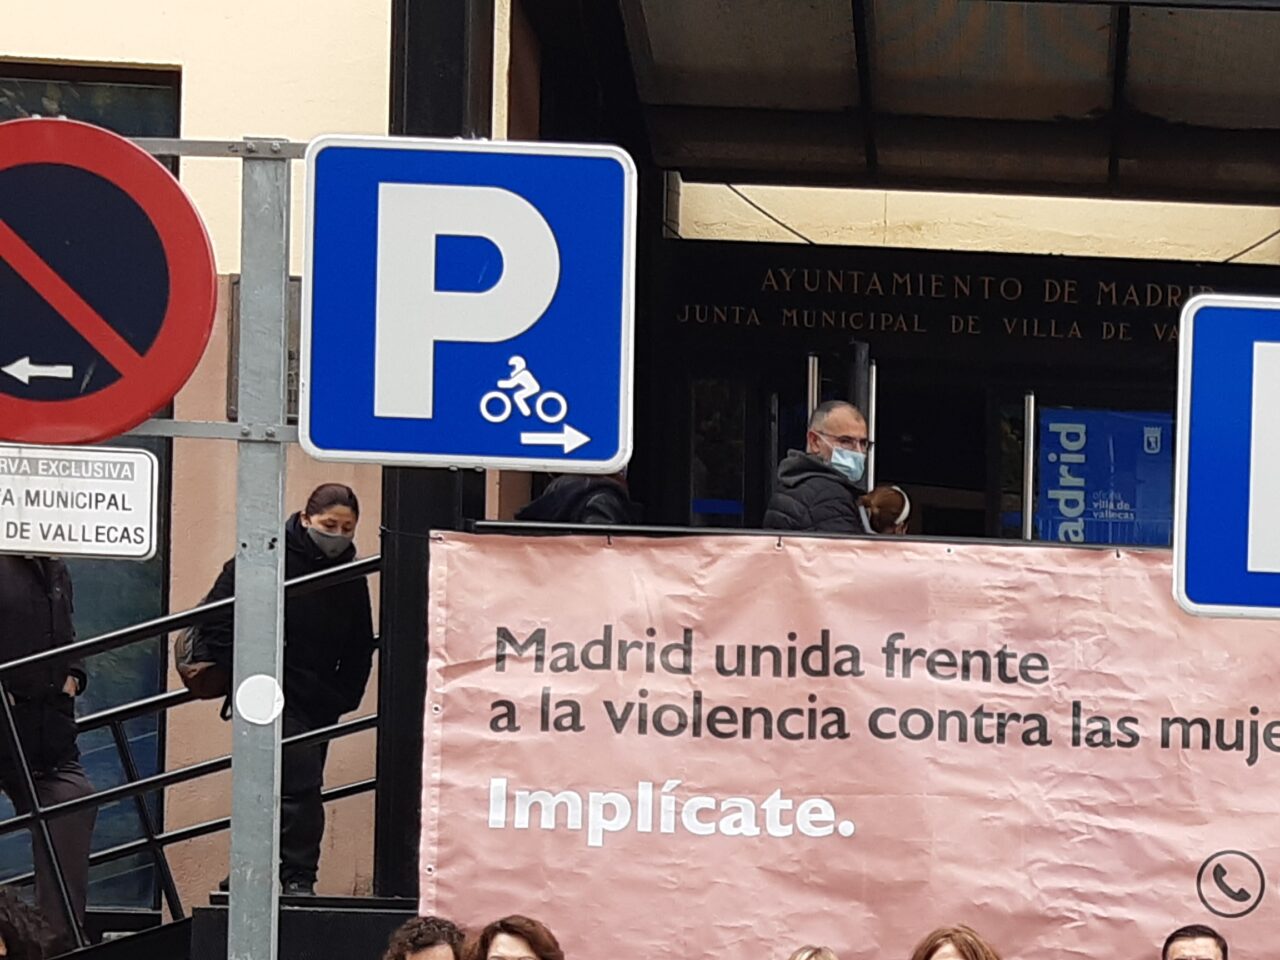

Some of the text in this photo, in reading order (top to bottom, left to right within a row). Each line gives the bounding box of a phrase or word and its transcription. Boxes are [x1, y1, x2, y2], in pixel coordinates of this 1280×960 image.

[374, 182, 561, 420] P
[761, 267, 1023, 300] AYUNTAMIENTO
[1044, 280, 1079, 304] DE
[676, 304, 761, 326] JUNTA
[782, 308, 928, 333] MUNICIPAL
[950, 315, 981, 335] DE
[1003, 317, 1083, 339] VILLA
[1102, 321, 1133, 341] DE
[38, 460, 133, 479] EXCLUSIVA
[25, 489, 132, 512] MUNICIPAL
[6, 521, 145, 545] DE VALLECAS
[496, 626, 1049, 684] Madrid unida frente
[489, 699, 520, 733] a
[540, 687, 585, 733] la
[603, 688, 850, 740] violencia
[868, 704, 1052, 747] contra
[1072, 701, 1140, 748] las
[488, 777, 855, 847] Implícate.
